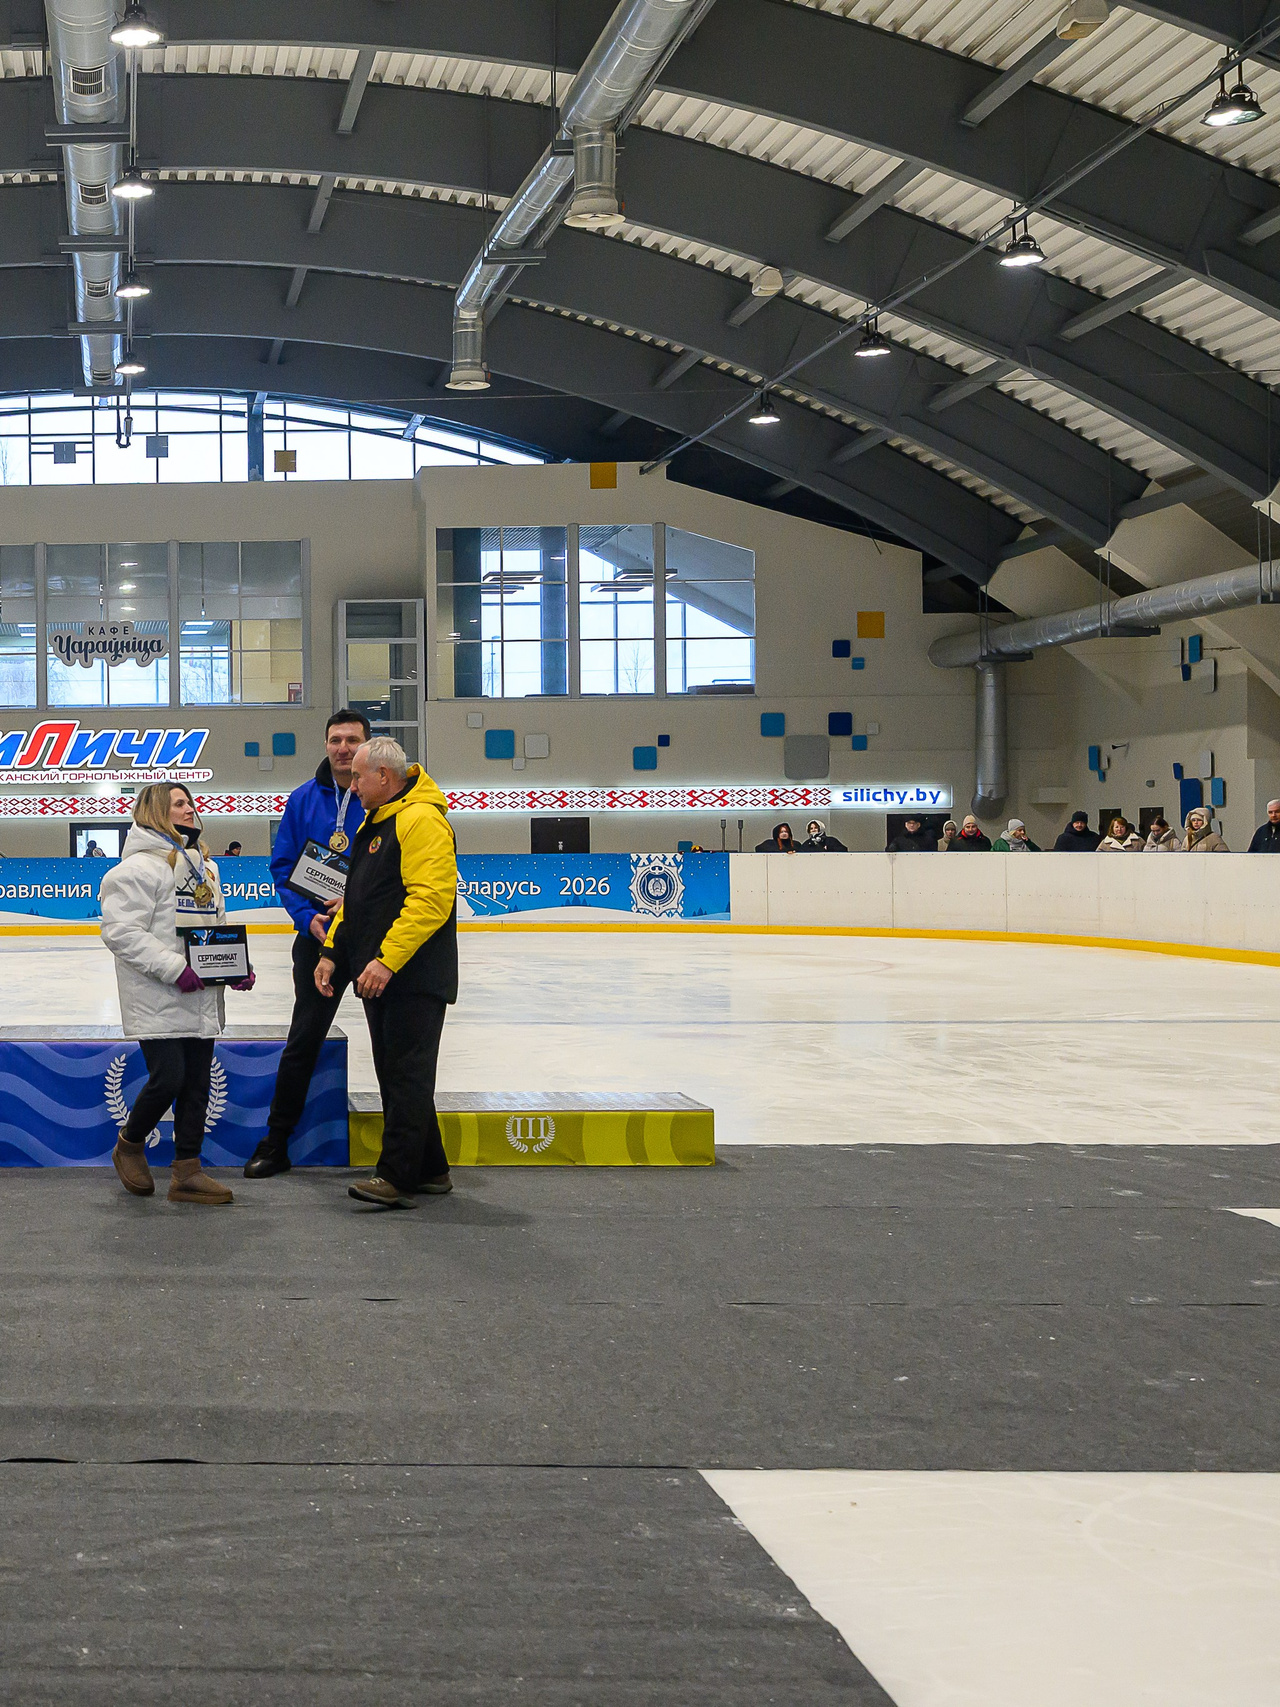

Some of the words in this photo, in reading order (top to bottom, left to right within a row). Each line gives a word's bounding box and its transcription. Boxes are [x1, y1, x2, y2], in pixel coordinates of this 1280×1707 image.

[88, 626, 129, 635] КАФЕ
[62, 770, 166, 781] ГОРНОЛЫЖНЫЙ
[169, 770, 211, 781] ЦЕНТР
[842, 788, 942, 805] silichy.by
[306, 866, 347, 891] СЕРТИФИК
[456, 880, 542, 900] еларусь
[559, 876, 611, 896] 2026
[197, 952, 238, 962] СЕРТИФИКАТ
[513, 1117, 548, 1139] III
